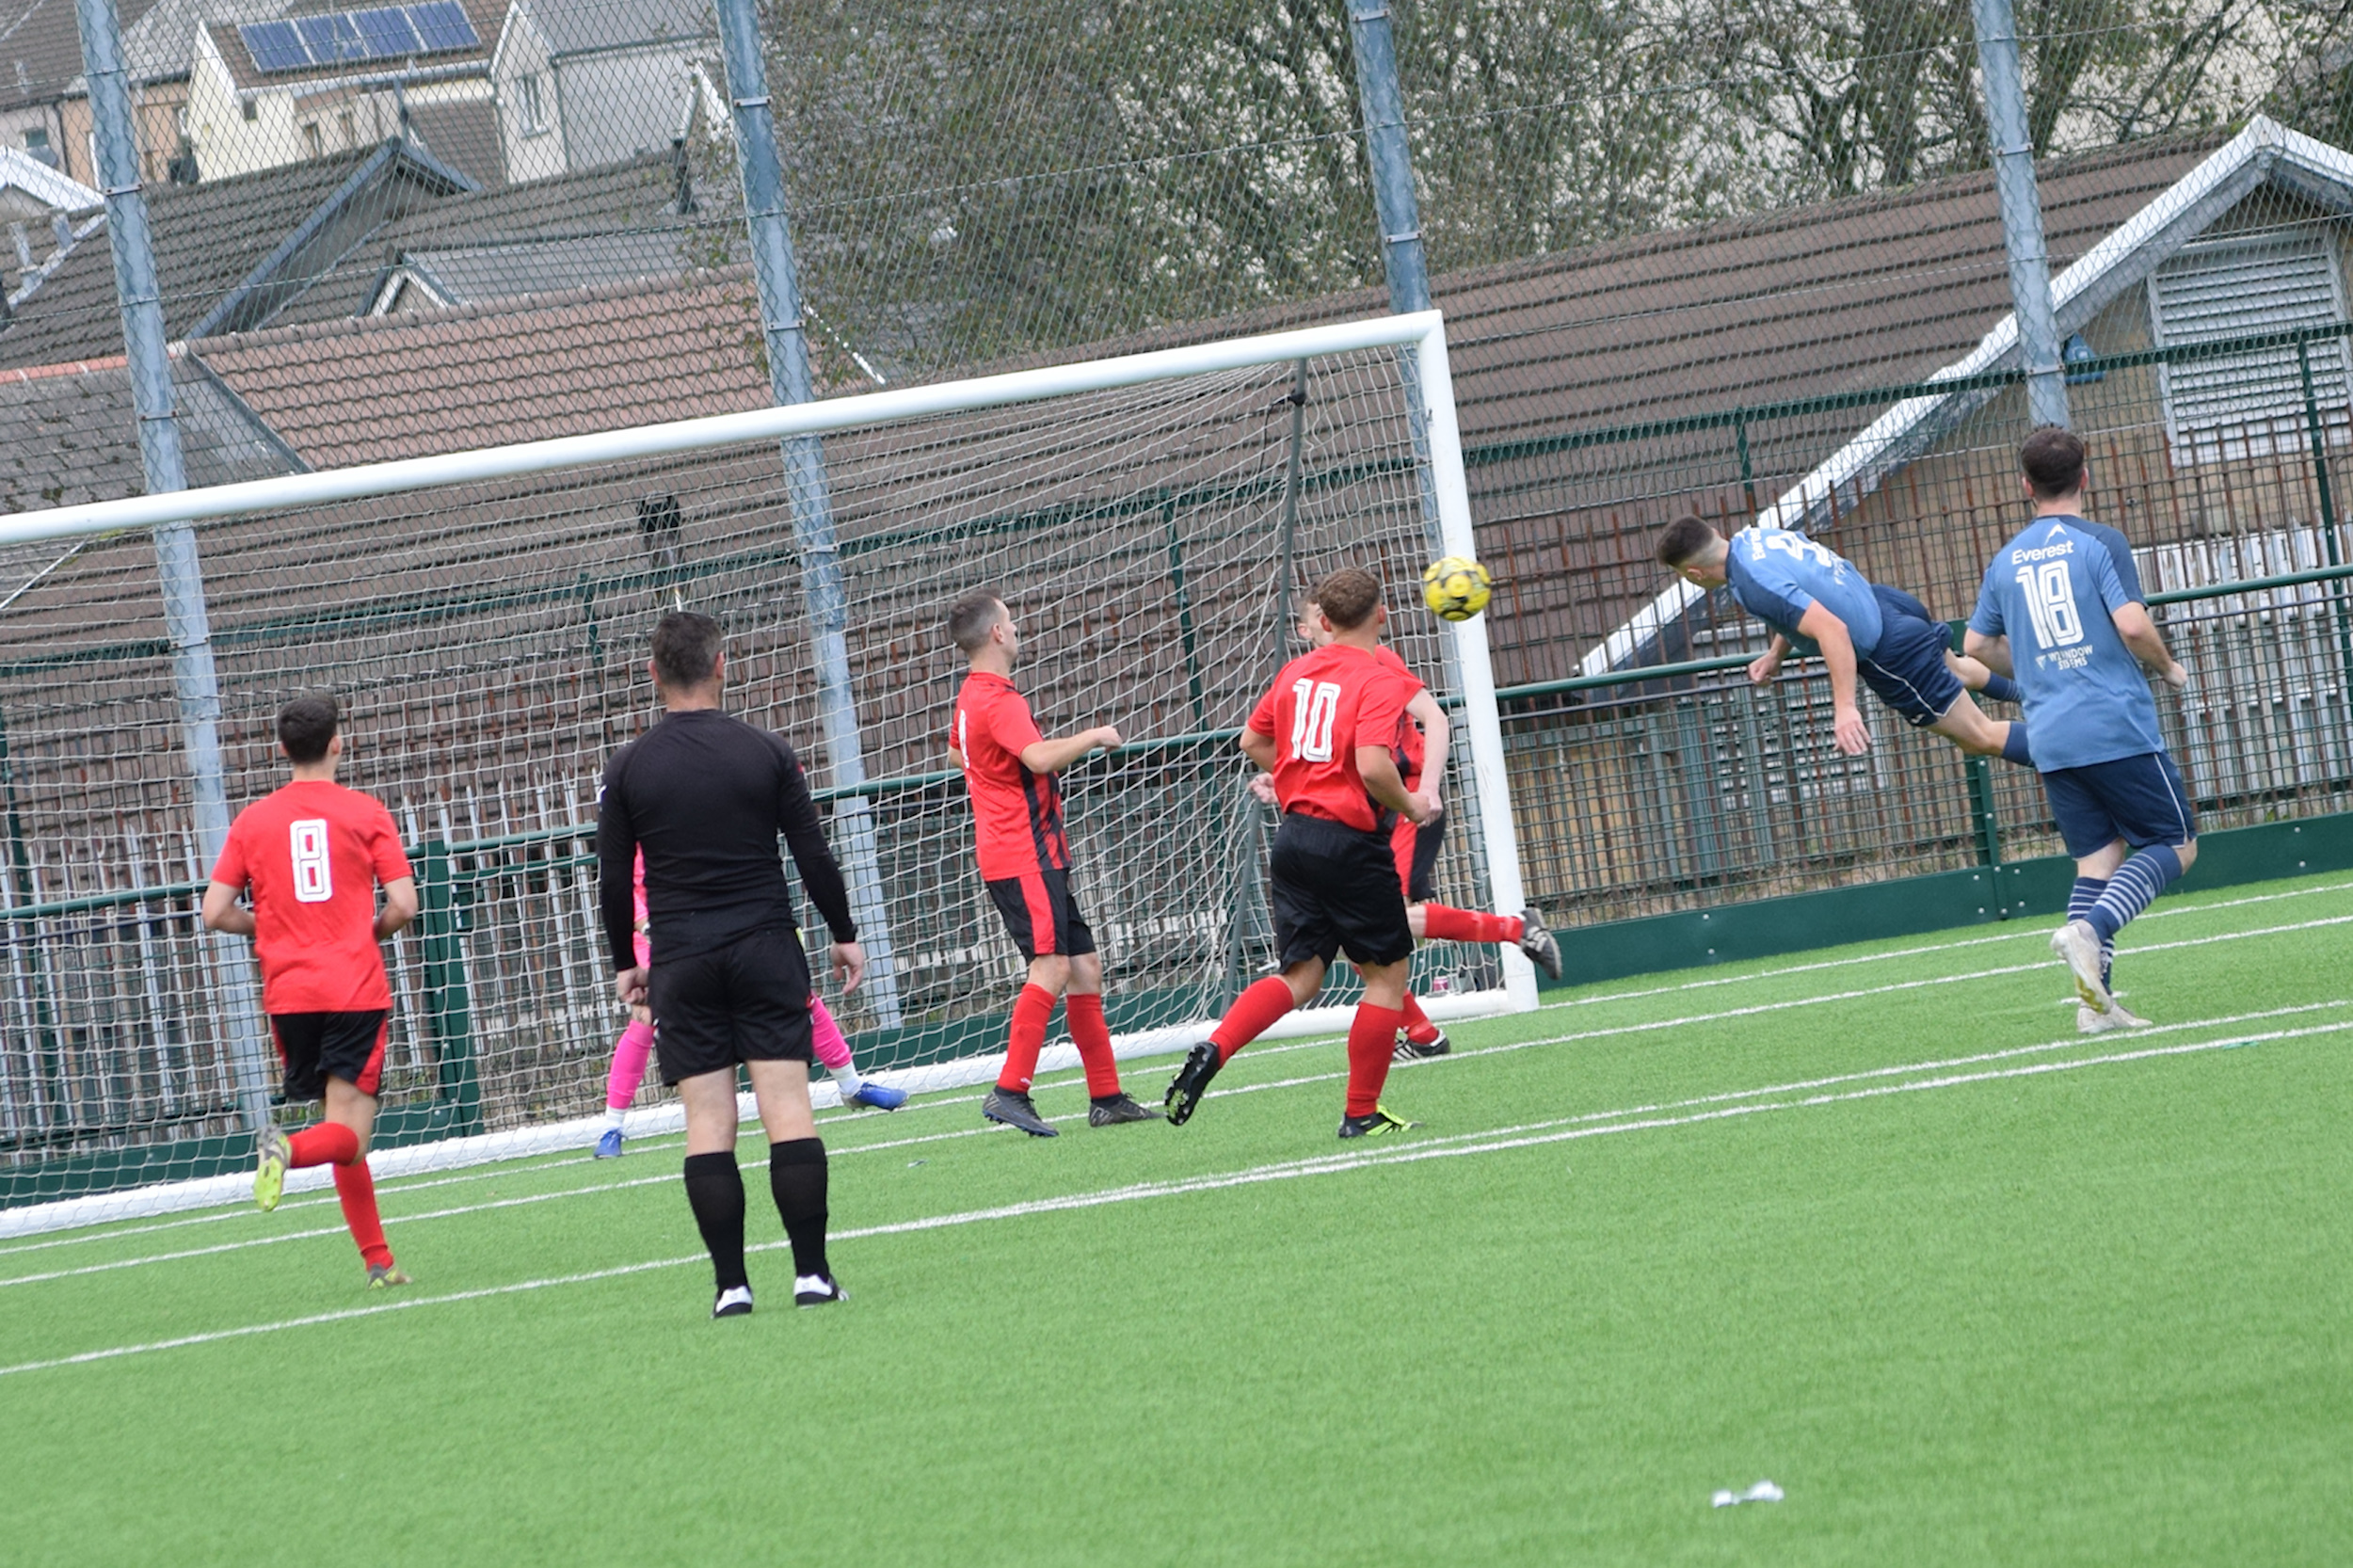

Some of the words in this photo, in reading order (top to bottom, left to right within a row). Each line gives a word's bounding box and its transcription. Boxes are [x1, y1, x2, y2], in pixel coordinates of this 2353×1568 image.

[2011, 540, 2074, 565] Everest
[2015, 560, 2084, 649] 18
[1291, 678, 1341, 762] 10
[289, 819, 333, 903] 8
